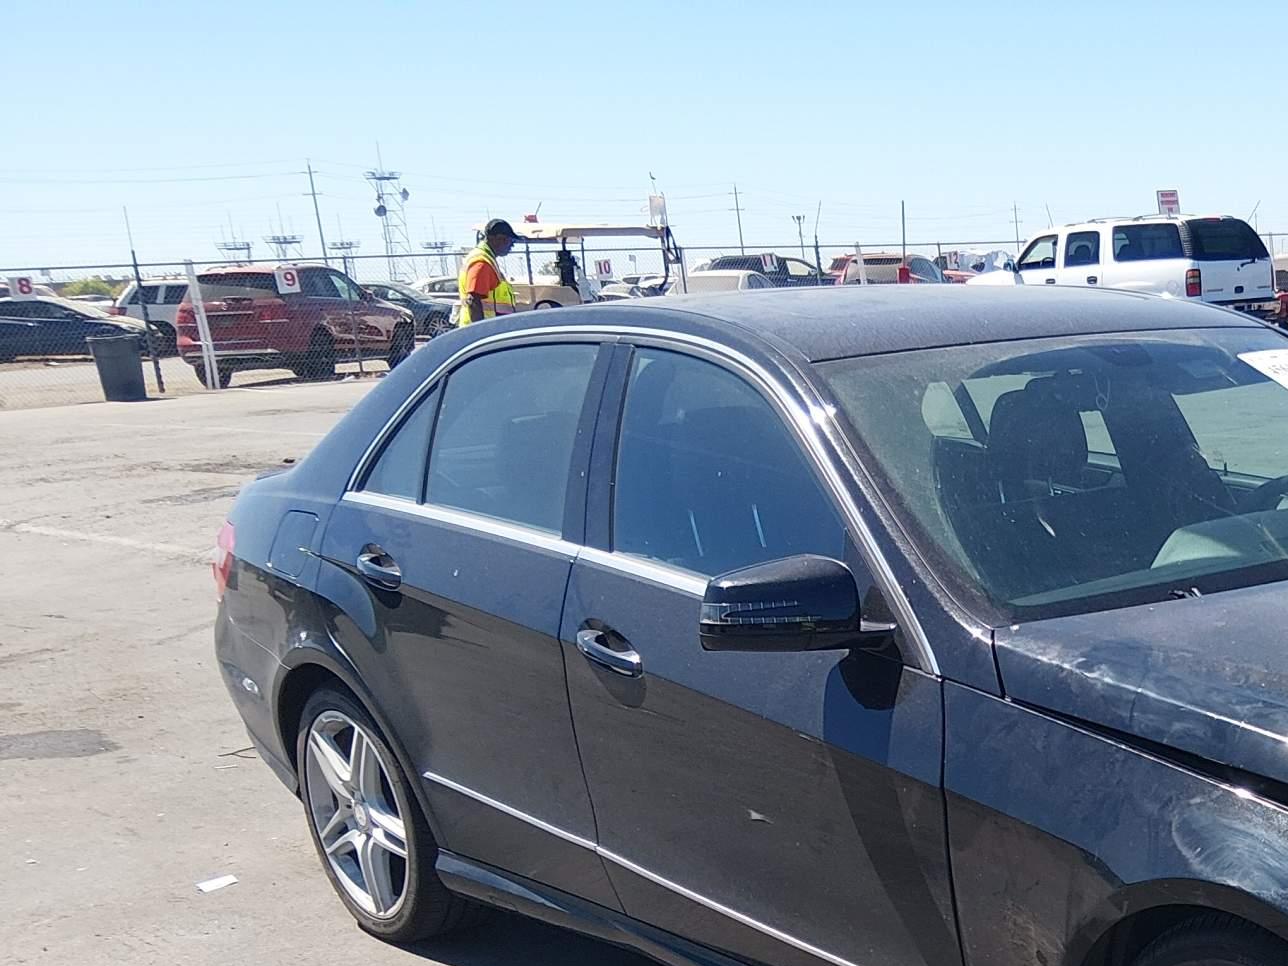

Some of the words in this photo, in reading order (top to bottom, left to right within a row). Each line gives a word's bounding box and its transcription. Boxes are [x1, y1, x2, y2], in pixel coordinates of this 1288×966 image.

[598, 260, 611, 275] 10
[17, 277, 33, 295] 8
[283, 271, 296, 287] 9
